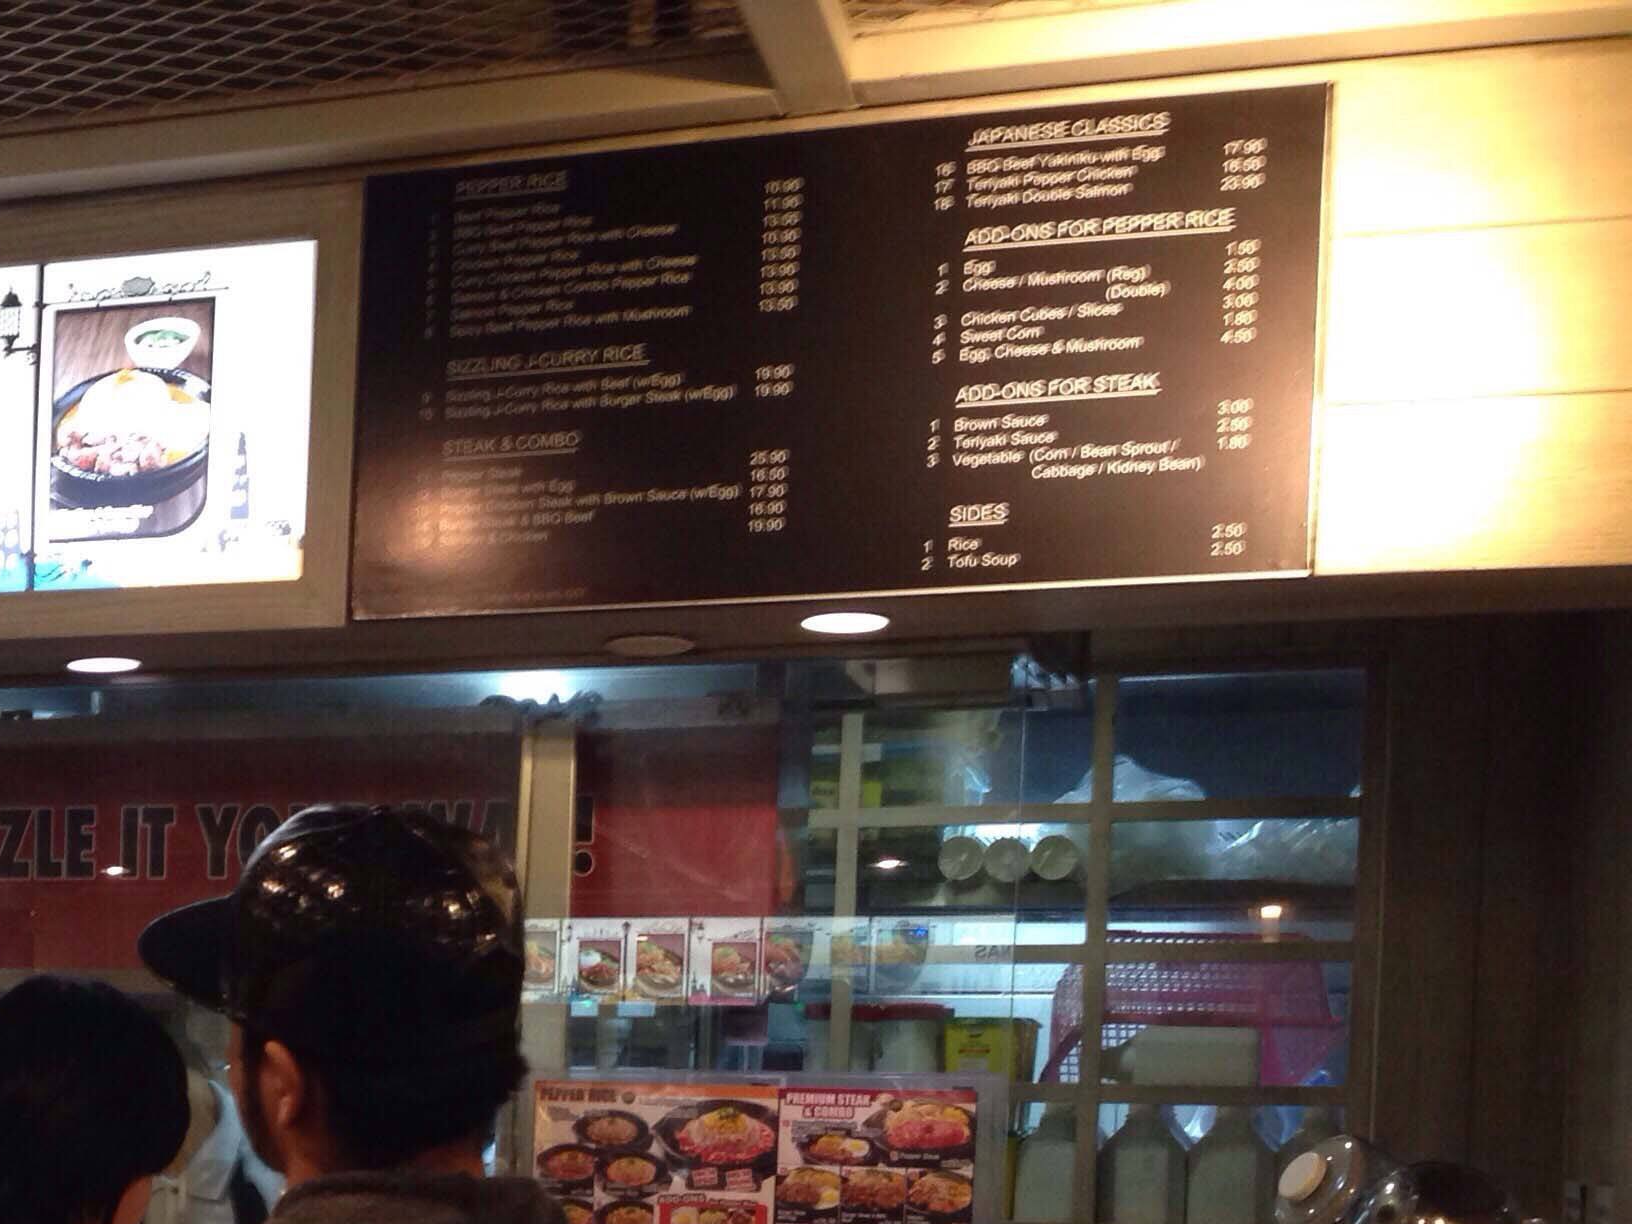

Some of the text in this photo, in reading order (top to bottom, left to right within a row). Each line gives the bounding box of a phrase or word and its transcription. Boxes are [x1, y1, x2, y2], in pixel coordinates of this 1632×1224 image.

[967, 112, 1171, 145] JAPANESE CLASSICS
[1002, 155, 1036, 172] Beef
[1099, 149, 1129, 162] with
[1131, 146, 1165, 162] Egg
[934, 179, 955, 193] 17
[1075, 165, 1138, 182] Chicken
[1074, 183, 1133, 199] Salmon
[964, 208, 1236, 245] ADD-ONS FOR PEPPER RICE
[935, 279, 949, 294] 2
[962, 272, 1017, 292] Cheese
[1027, 269, 1105, 287] Mushroom
[1105, 264, 1151, 284] (Reg)
[936, 263, 949, 276] 1
[963, 260, 996, 277] Egg
[1104, 274, 1260, 302] (Double) 4.00
[933, 292, 1259, 330] 3 Chicken Cubes Slices 3.00
[959, 328, 1004, 344] Sweet
[602, 343, 648, 362] RICE
[931, 350, 945, 364] 5
[994, 343, 1049, 359] Cheese
[1050, 341, 1064, 354] &
[1065, 337, 1144, 353] Mushroom
[955, 372, 1160, 402] ADD-ONS FOR STEAK
[929, 398, 1254, 433] 1 Brown Sauce 3.00
[515, 430, 582, 450] COMBO
[927, 436, 941, 450] 2
[953, 434, 1007, 450] Teriyaki
[1010, 431, 1059, 445] Sauce
[926, 453, 940, 468] 3
[952, 450, 1025, 468] Vegetable
[1079, 444, 1118, 459] Bean
[1031, 455, 1205, 480] Cabbage Kidney Bean)
[749, 483, 788, 498] 17.90
[747, 517, 786, 532] 19.90
[948, 502, 1009, 523] SIDES
[923, 522, 1248, 553] 1 Rice 2.50
[921, 540, 1246, 570] 2 Tofu Soup 2.50
[119, 804, 177, 881] IT
